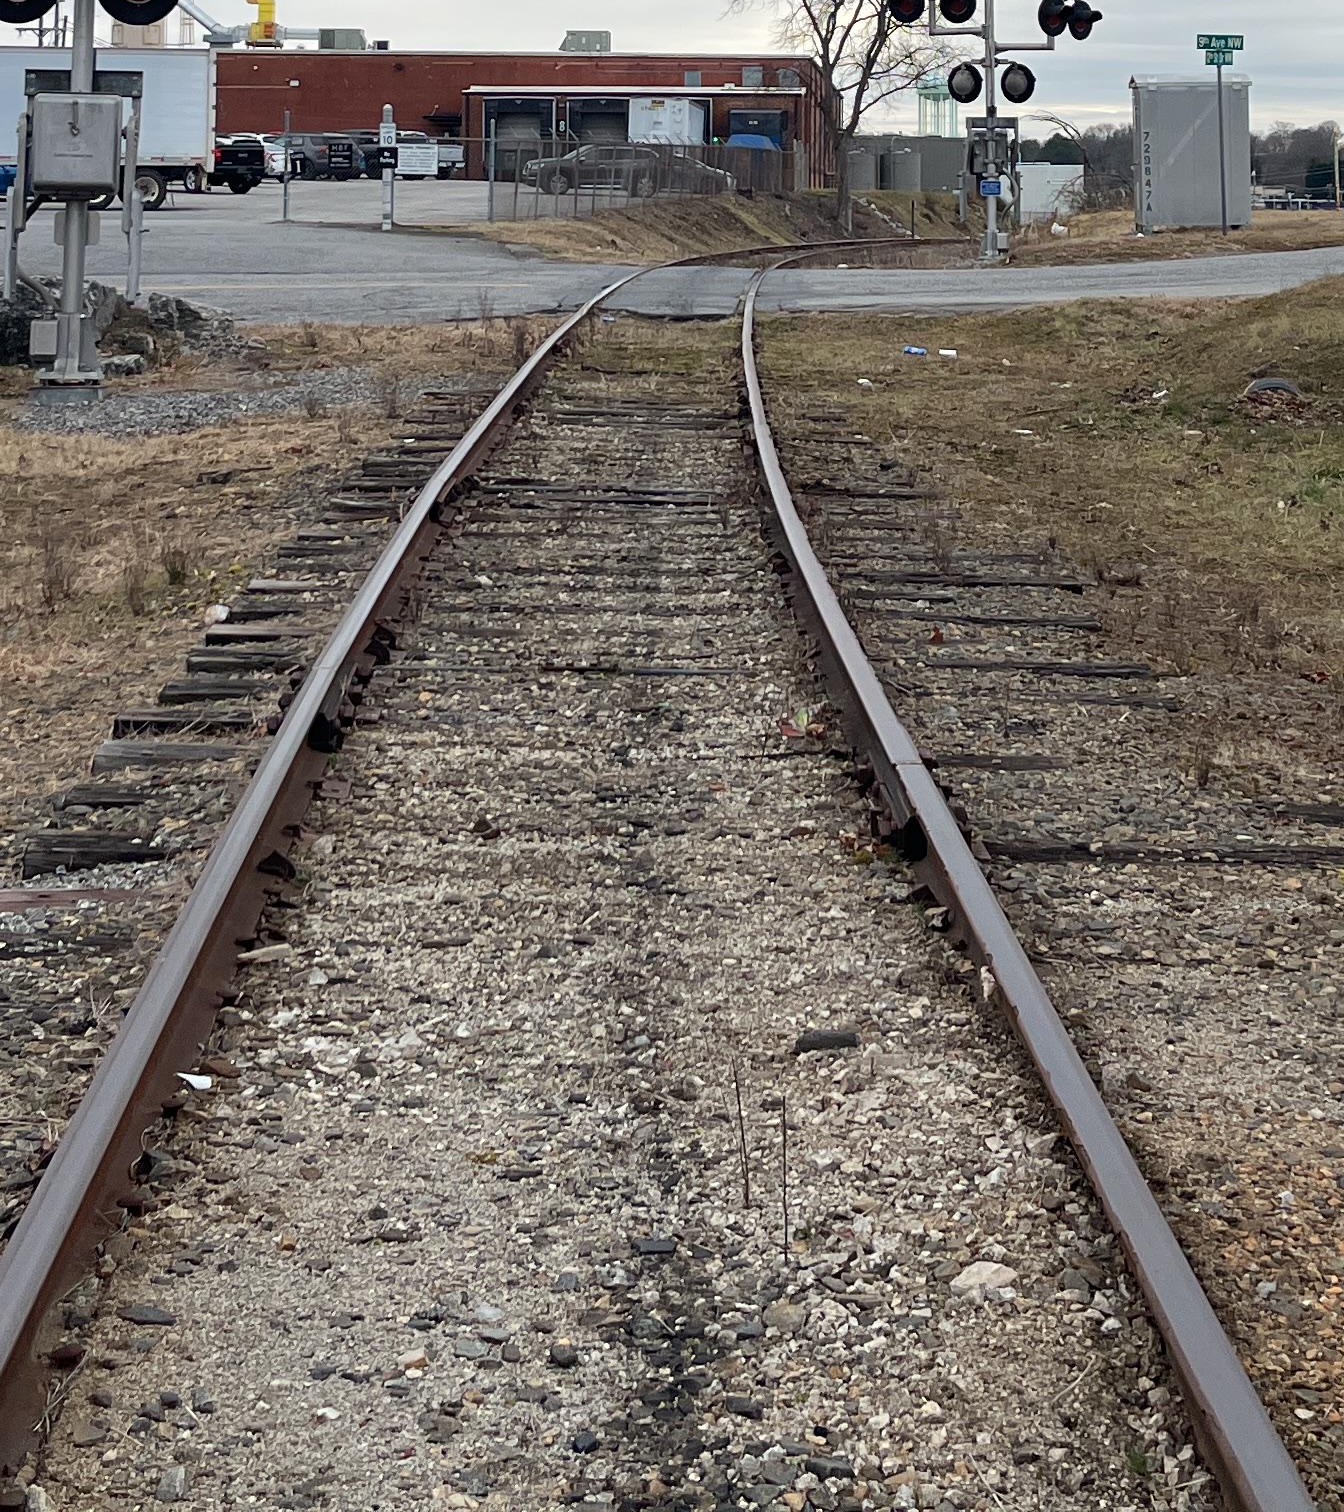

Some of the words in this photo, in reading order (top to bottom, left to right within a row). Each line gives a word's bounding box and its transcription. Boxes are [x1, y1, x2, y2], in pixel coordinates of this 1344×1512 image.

[1210, 37, 1226, 48] Ave
[1227, 37, 1242, 49] NW
[382, 135, 393, 145] 10
[1143, 131, 1152, 212] 729847A
